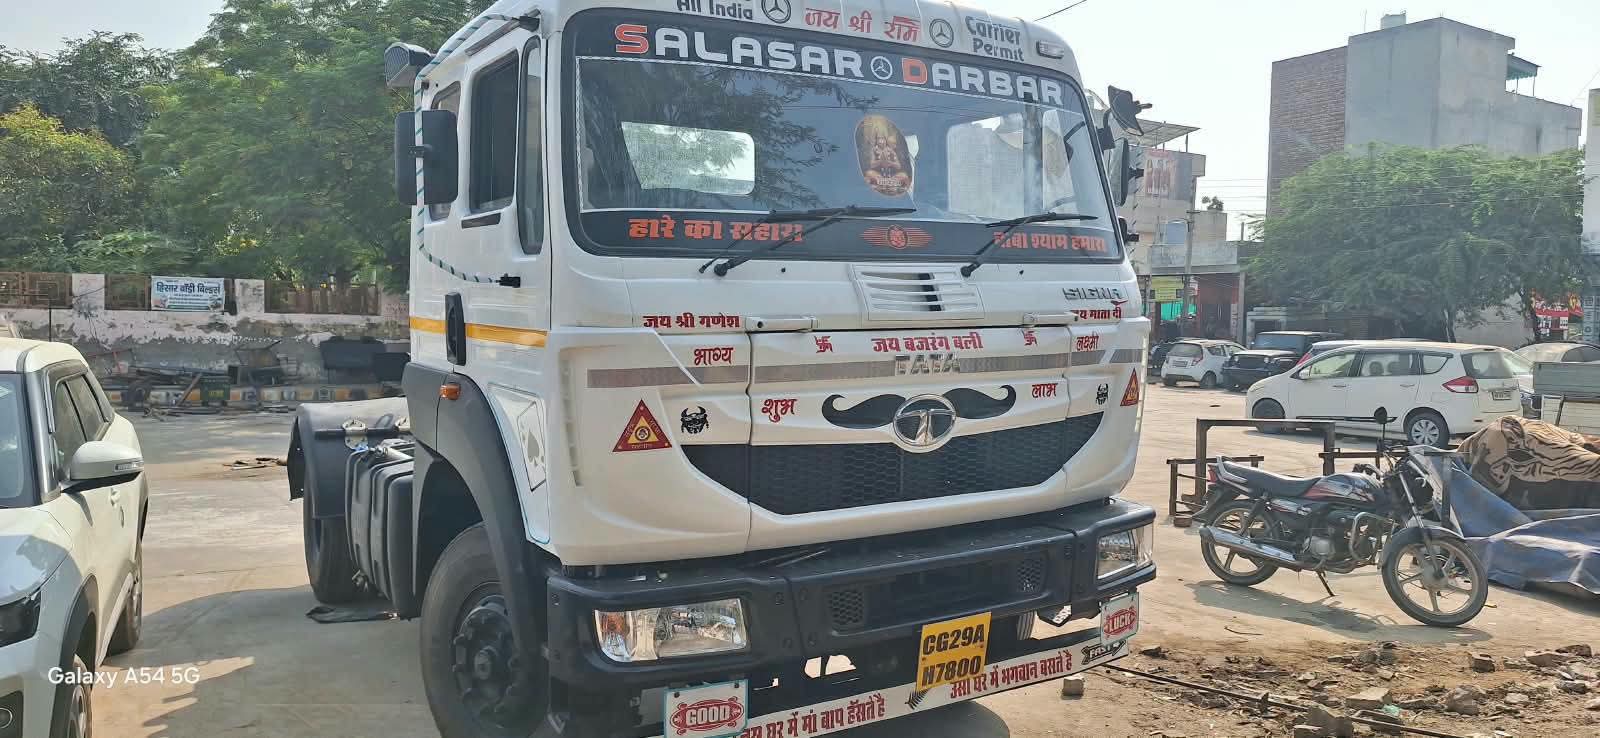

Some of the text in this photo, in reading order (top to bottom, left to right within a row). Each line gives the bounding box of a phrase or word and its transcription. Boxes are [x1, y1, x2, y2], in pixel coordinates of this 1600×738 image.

[709, 0, 753, 20] India
[805, 8, 922, 42] जय श्री राम
[965, 15, 1022, 46] Carrier
[972, 38, 1025, 62] Permit
[614, 23, 1064, 106] SALASAR DARBAR
[628, 214, 677, 240] हारे
[683, 219, 723, 241] का
[1031, 233, 1068, 250] श्याम
[1071, 235, 1107, 252] हमारा
[156, 281, 178, 293] हिसार
[180, 282, 196, 294] बॉडी
[1063, 287, 1124, 300] SIGNA
[643, 312, 740, 329] जय श्री गणेश
[1089, 310, 1111, 321] माता
[1112, 306, 1122, 320] दी
[871, 331, 983, 352] जय बजरंग बली
[693, 347, 734, 366] भाग्य
[1031, 382, 1058, 398] लाभ
[761, 398, 798, 423] शुभ
[1109, 612, 1131, 632] LUCK
[922, 624, 985, 656] CG29A
[1002, 661, 1038, 686] भगवान
[685, 706, 731, 725] GOOD
[787, 711, 799, 737] में
[821, 707, 845, 730] बाप
